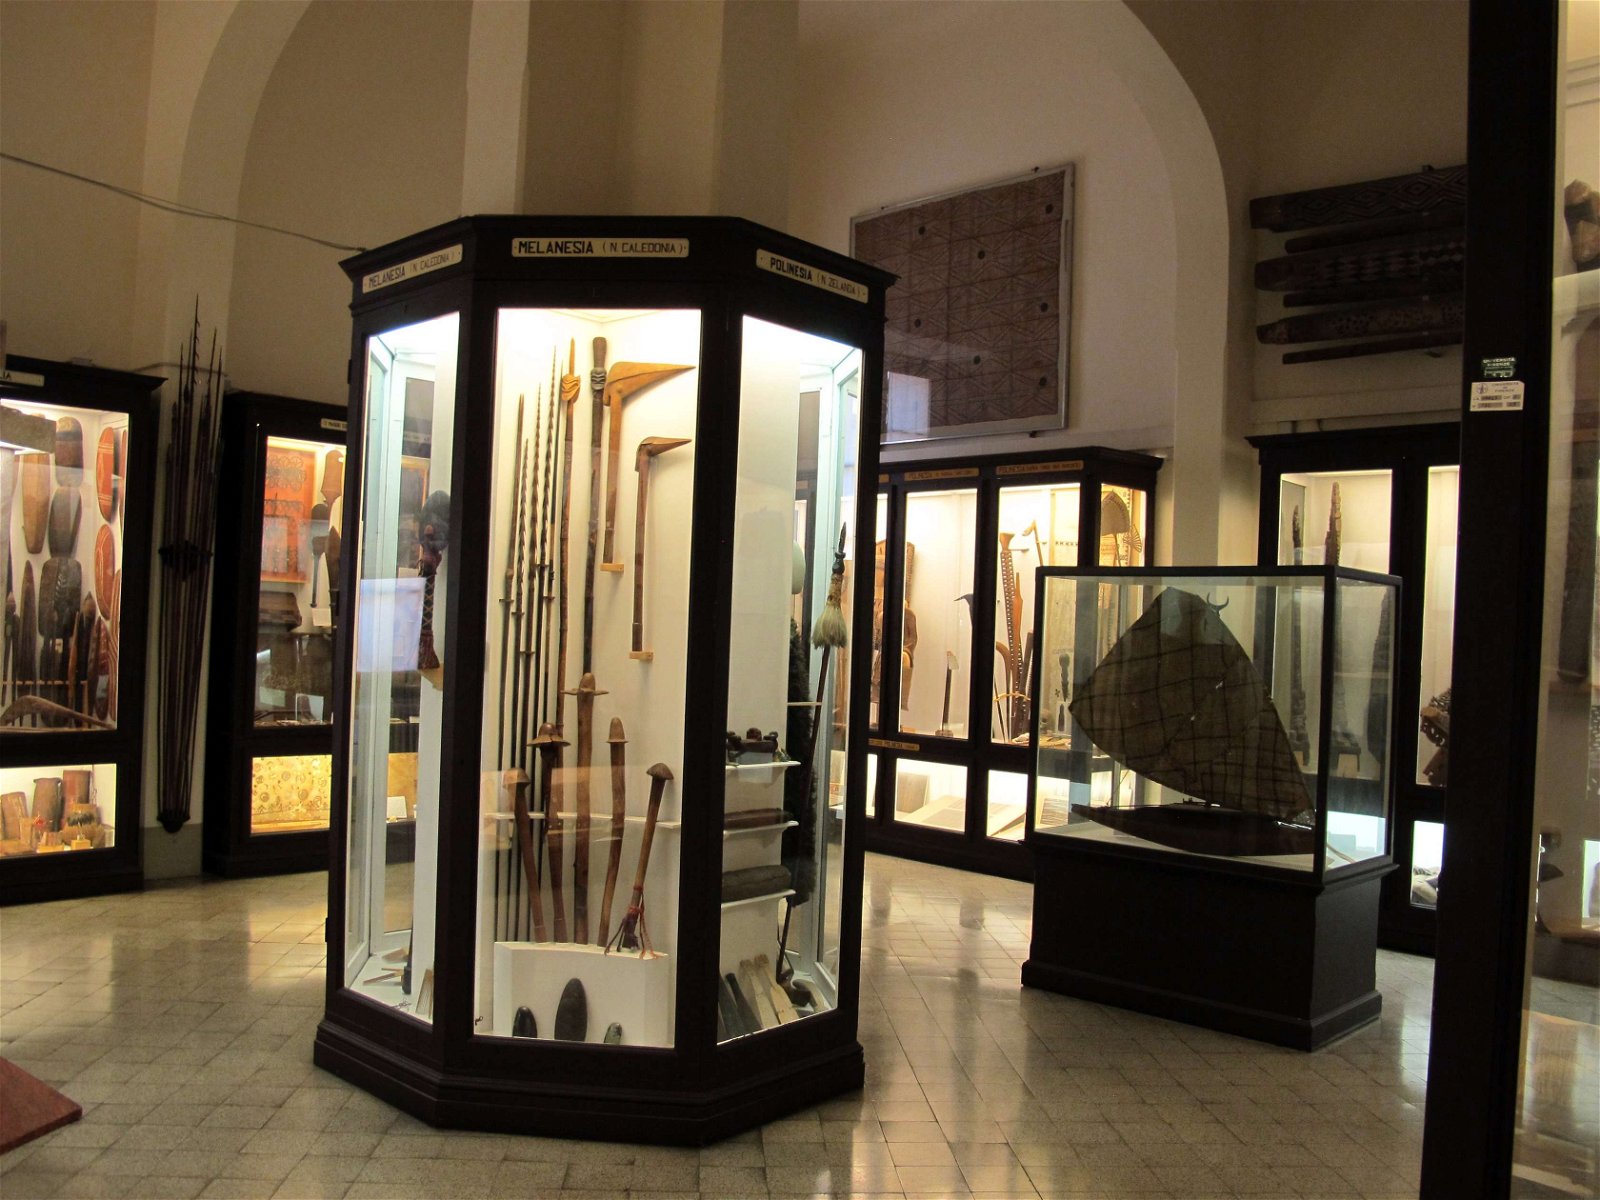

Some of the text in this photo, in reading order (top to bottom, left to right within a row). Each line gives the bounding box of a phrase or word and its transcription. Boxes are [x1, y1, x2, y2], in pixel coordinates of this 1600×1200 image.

[518, 240, 594, 255] MELANESIA
[368, 266, 406, 289] MELANESIA
[770, 256, 813, 281] POLINESIA
